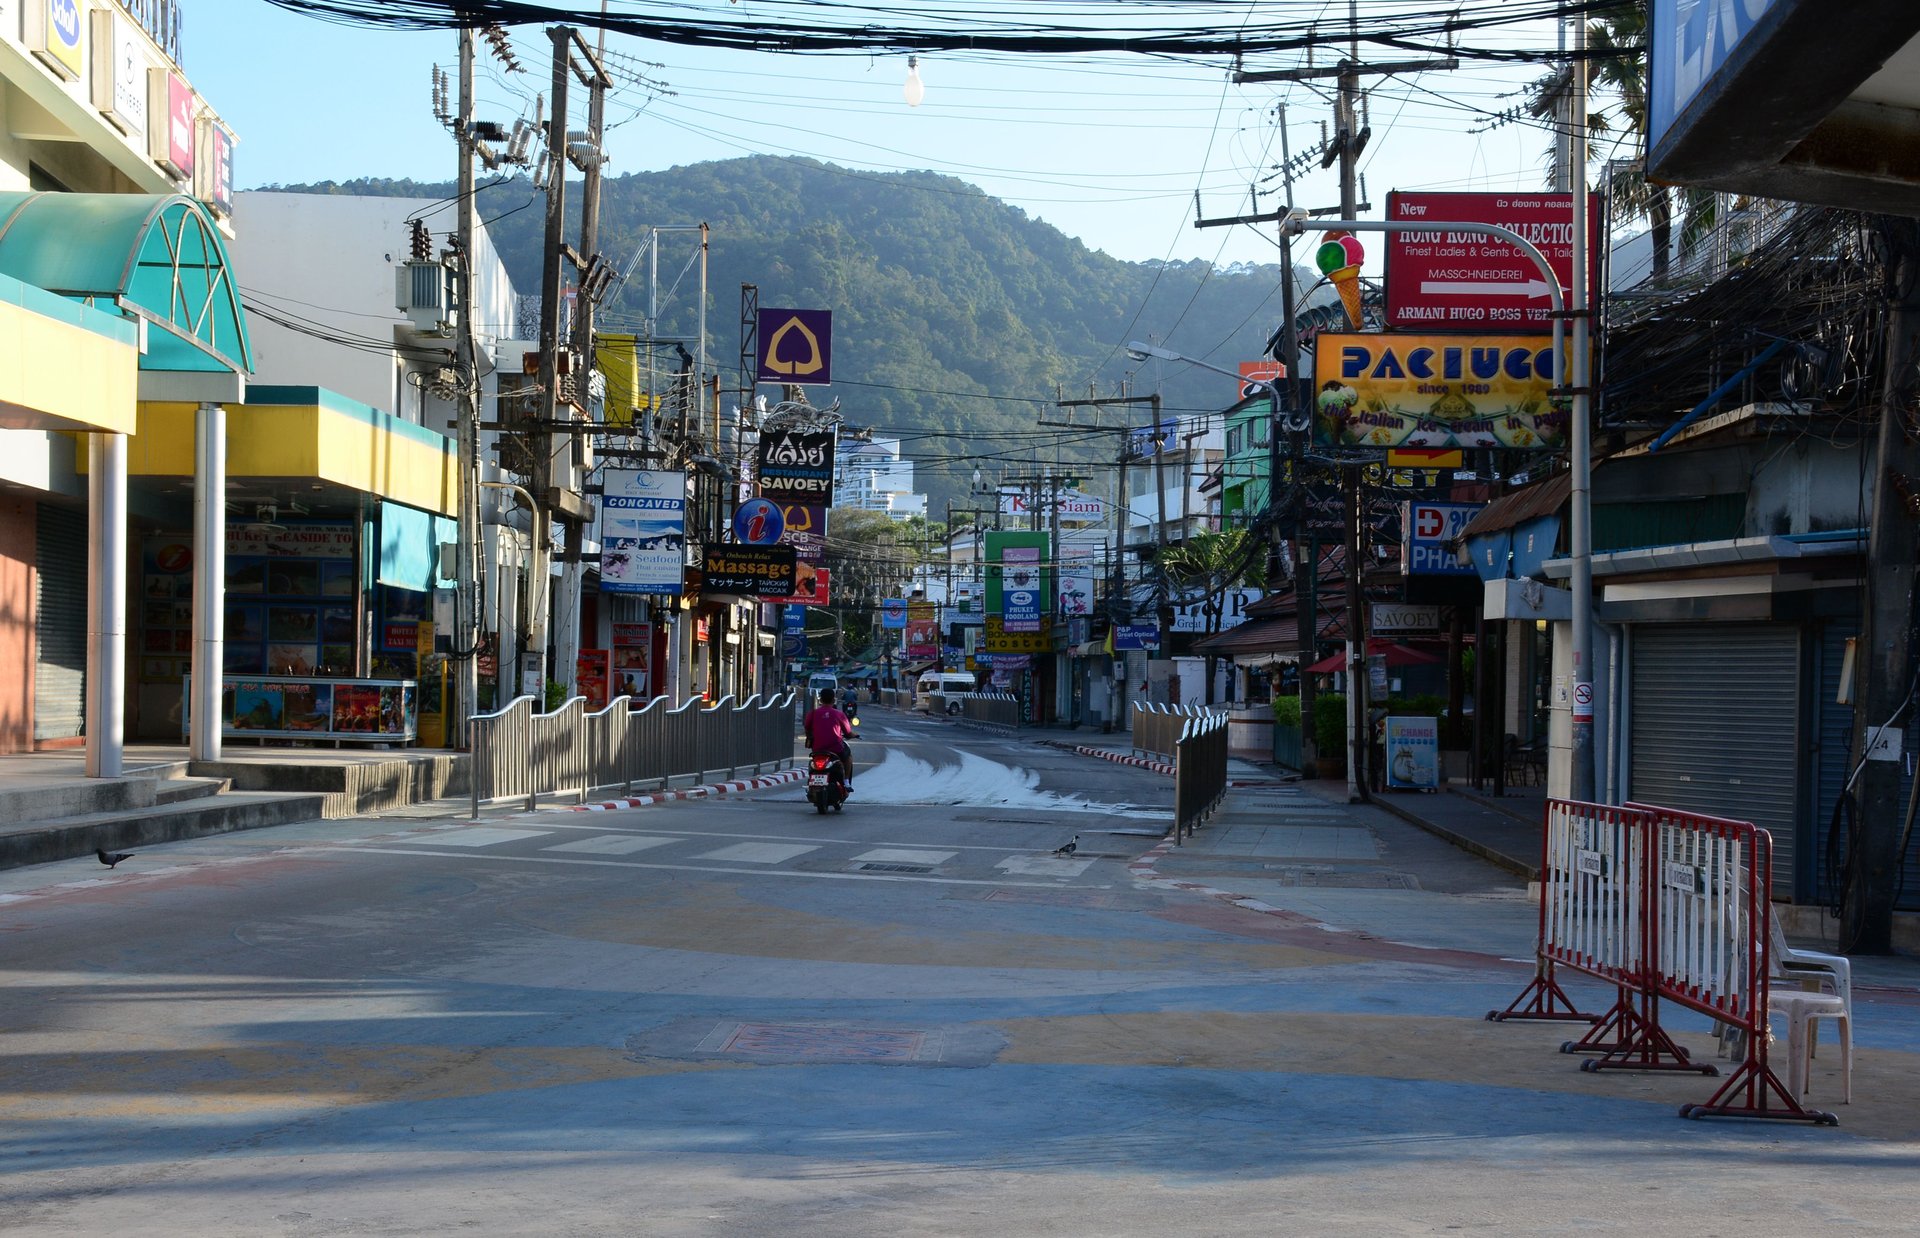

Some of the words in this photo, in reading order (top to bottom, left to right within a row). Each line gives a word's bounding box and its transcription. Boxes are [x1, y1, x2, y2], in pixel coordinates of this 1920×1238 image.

[1399, 203, 1427, 216] New
[1405, 246, 1431, 256] Finest
[1435, 246, 1466, 257] Ladies
[1469, 247, 1477, 257] &
[1481, 247, 1509, 258] Gents
[1428, 270, 1523, 280] MASSCHNEIDEREI
[1397, 307, 1445, 320] ARMANI
[1450, 307, 1485, 320] HUGO
[1489, 308, 1521, 321] BOSS
[1417, 384, 1449, 395] since
[1461, 384, 1490, 395] 1989
[1359, 410, 1404, 431] Italian
[1507, 414, 1522, 432] in
[761, 468, 830, 479] RESTAURANT
[760, 477, 830, 492] SAVOEY
[609, 498, 680, 509] CONCAVED
[783, 531, 809, 543] SCB
[636, 553, 681, 564] Seafood
[707, 559, 791, 579] Massage
[709, 578, 753, 588] マッサージ
[1374, 612, 1437, 627] SAVOEY
[1392, 726, 1434, 738] EXCHANGE
